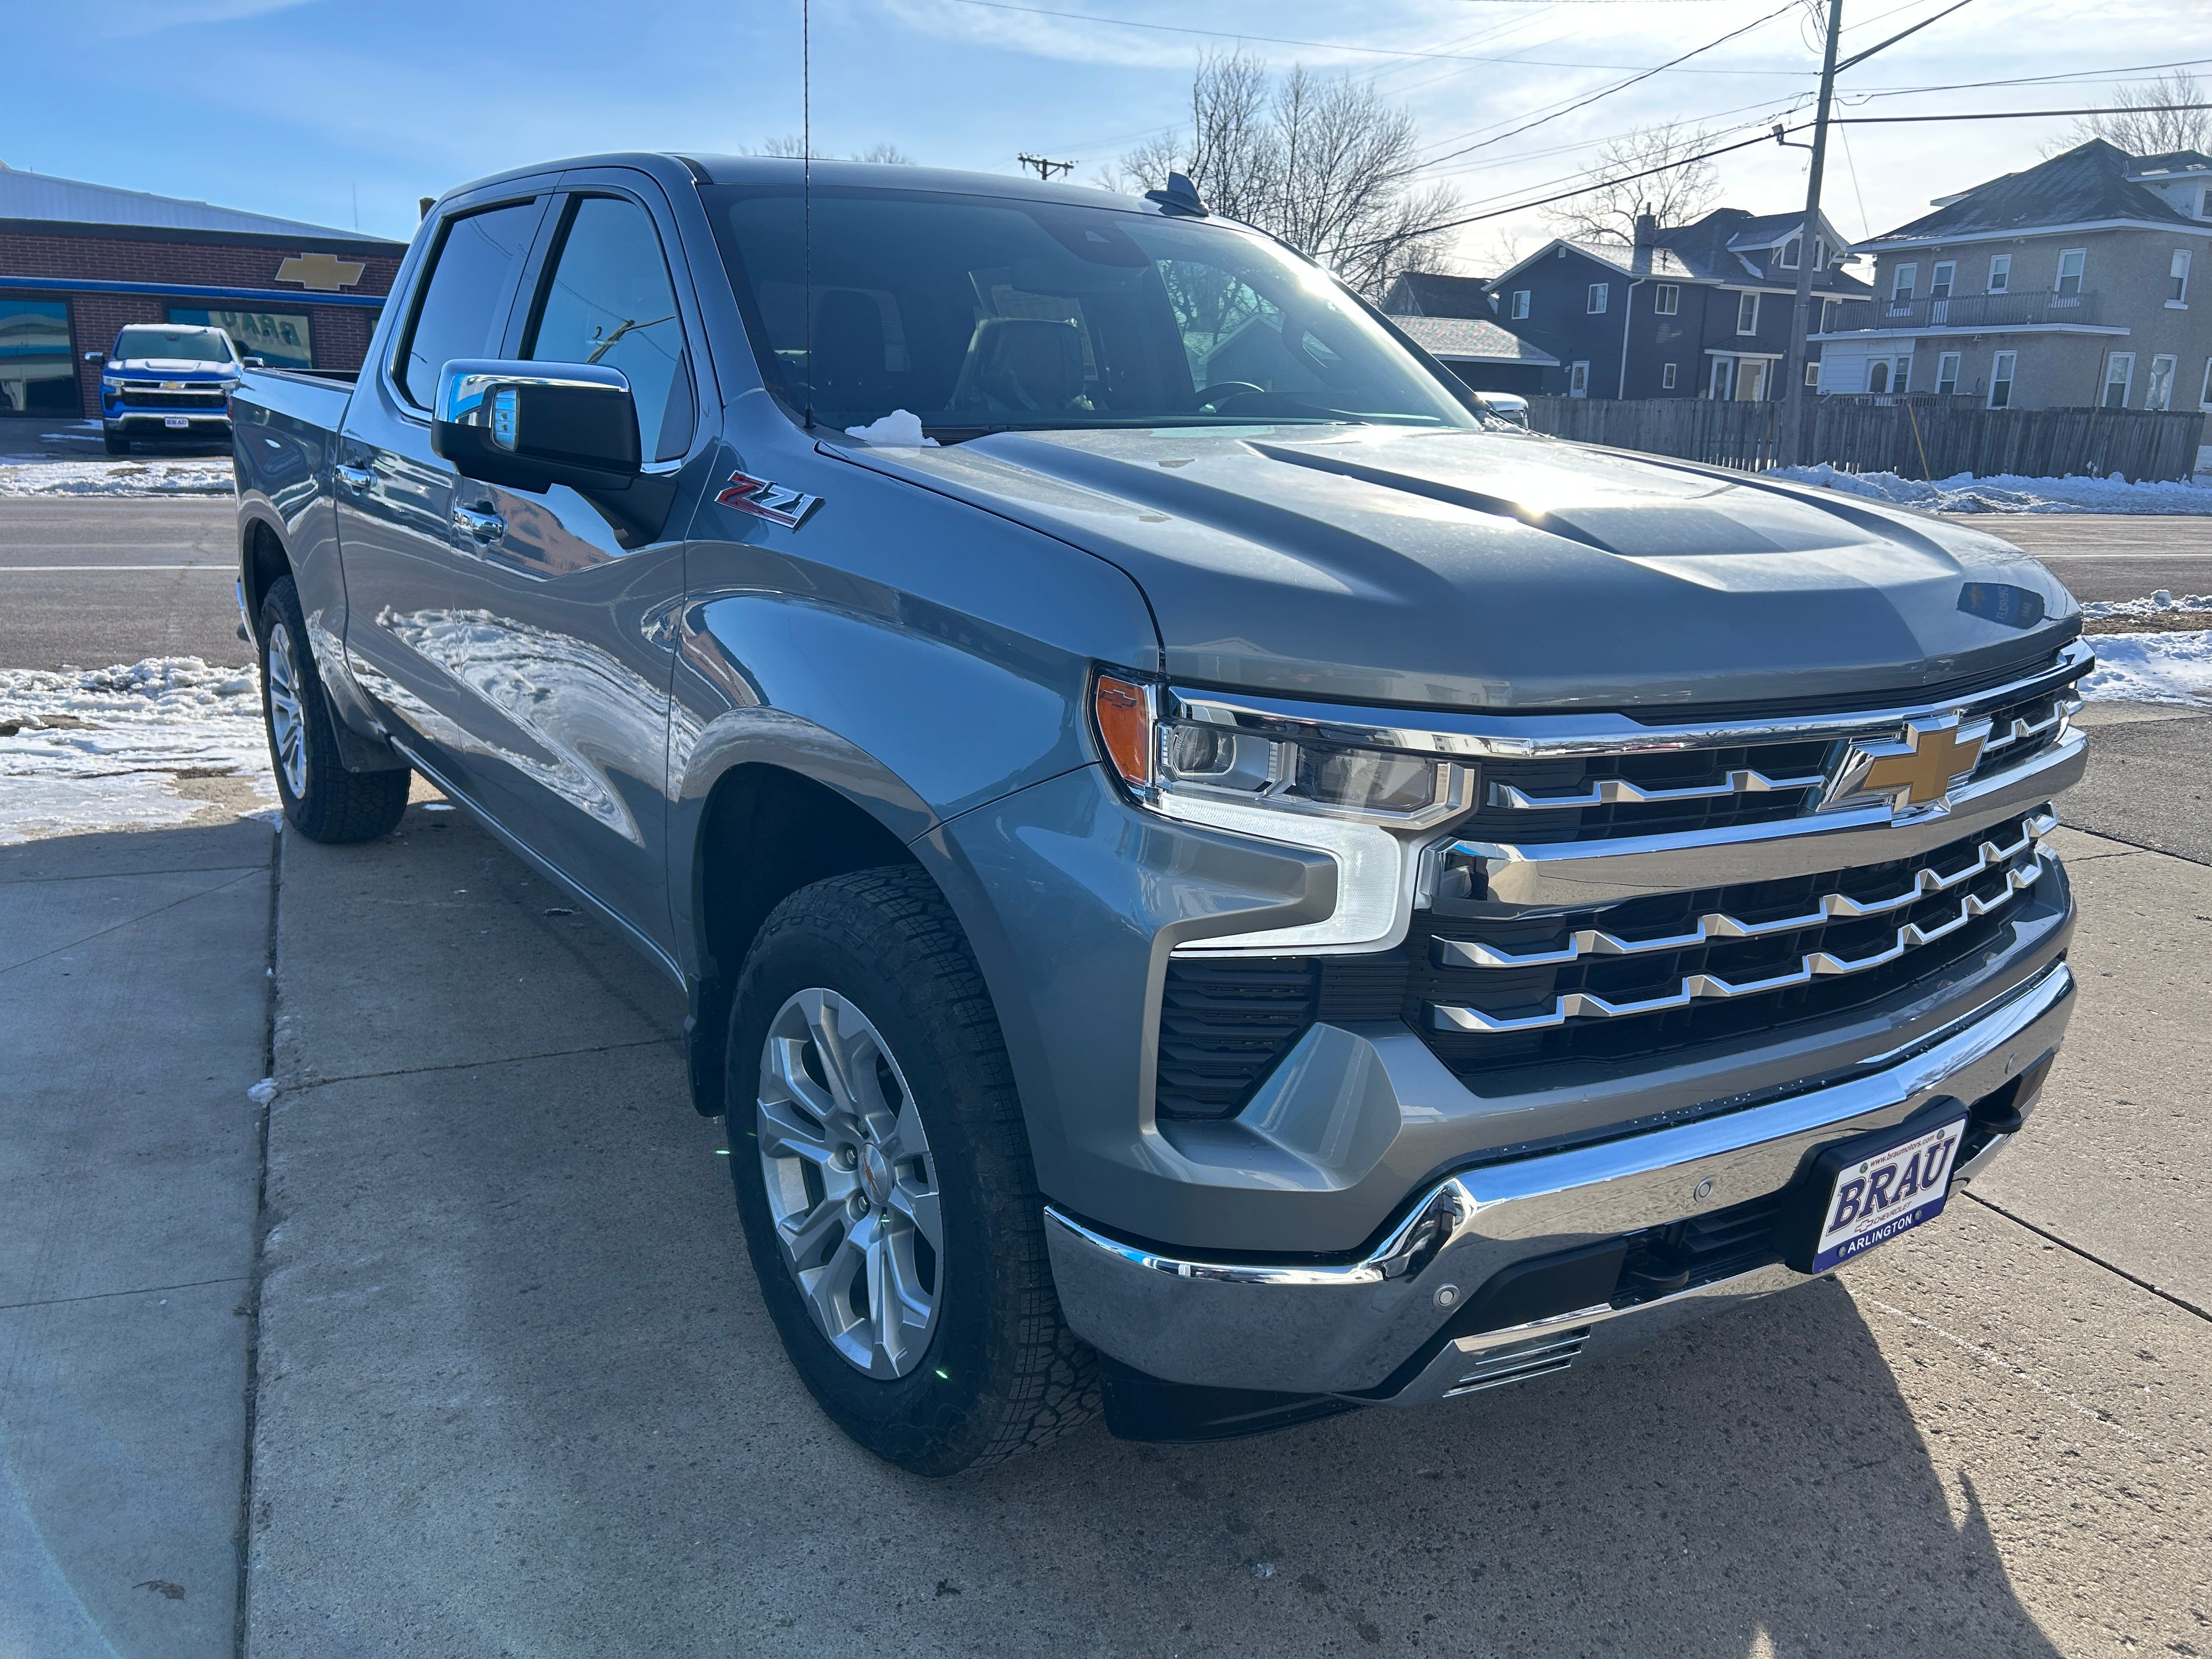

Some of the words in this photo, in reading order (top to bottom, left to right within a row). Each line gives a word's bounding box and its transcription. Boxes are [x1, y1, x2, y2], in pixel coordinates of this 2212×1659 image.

[714, 470, 825, 528] Z71
[1870, 1135, 1935, 1167] www.braumotors.com
[1826, 1134, 1957, 1237] BRAU
[1873, 1200, 1912, 1224] CHEVROLET
[1847, 1213, 1912, 1254] ARLINGTON
